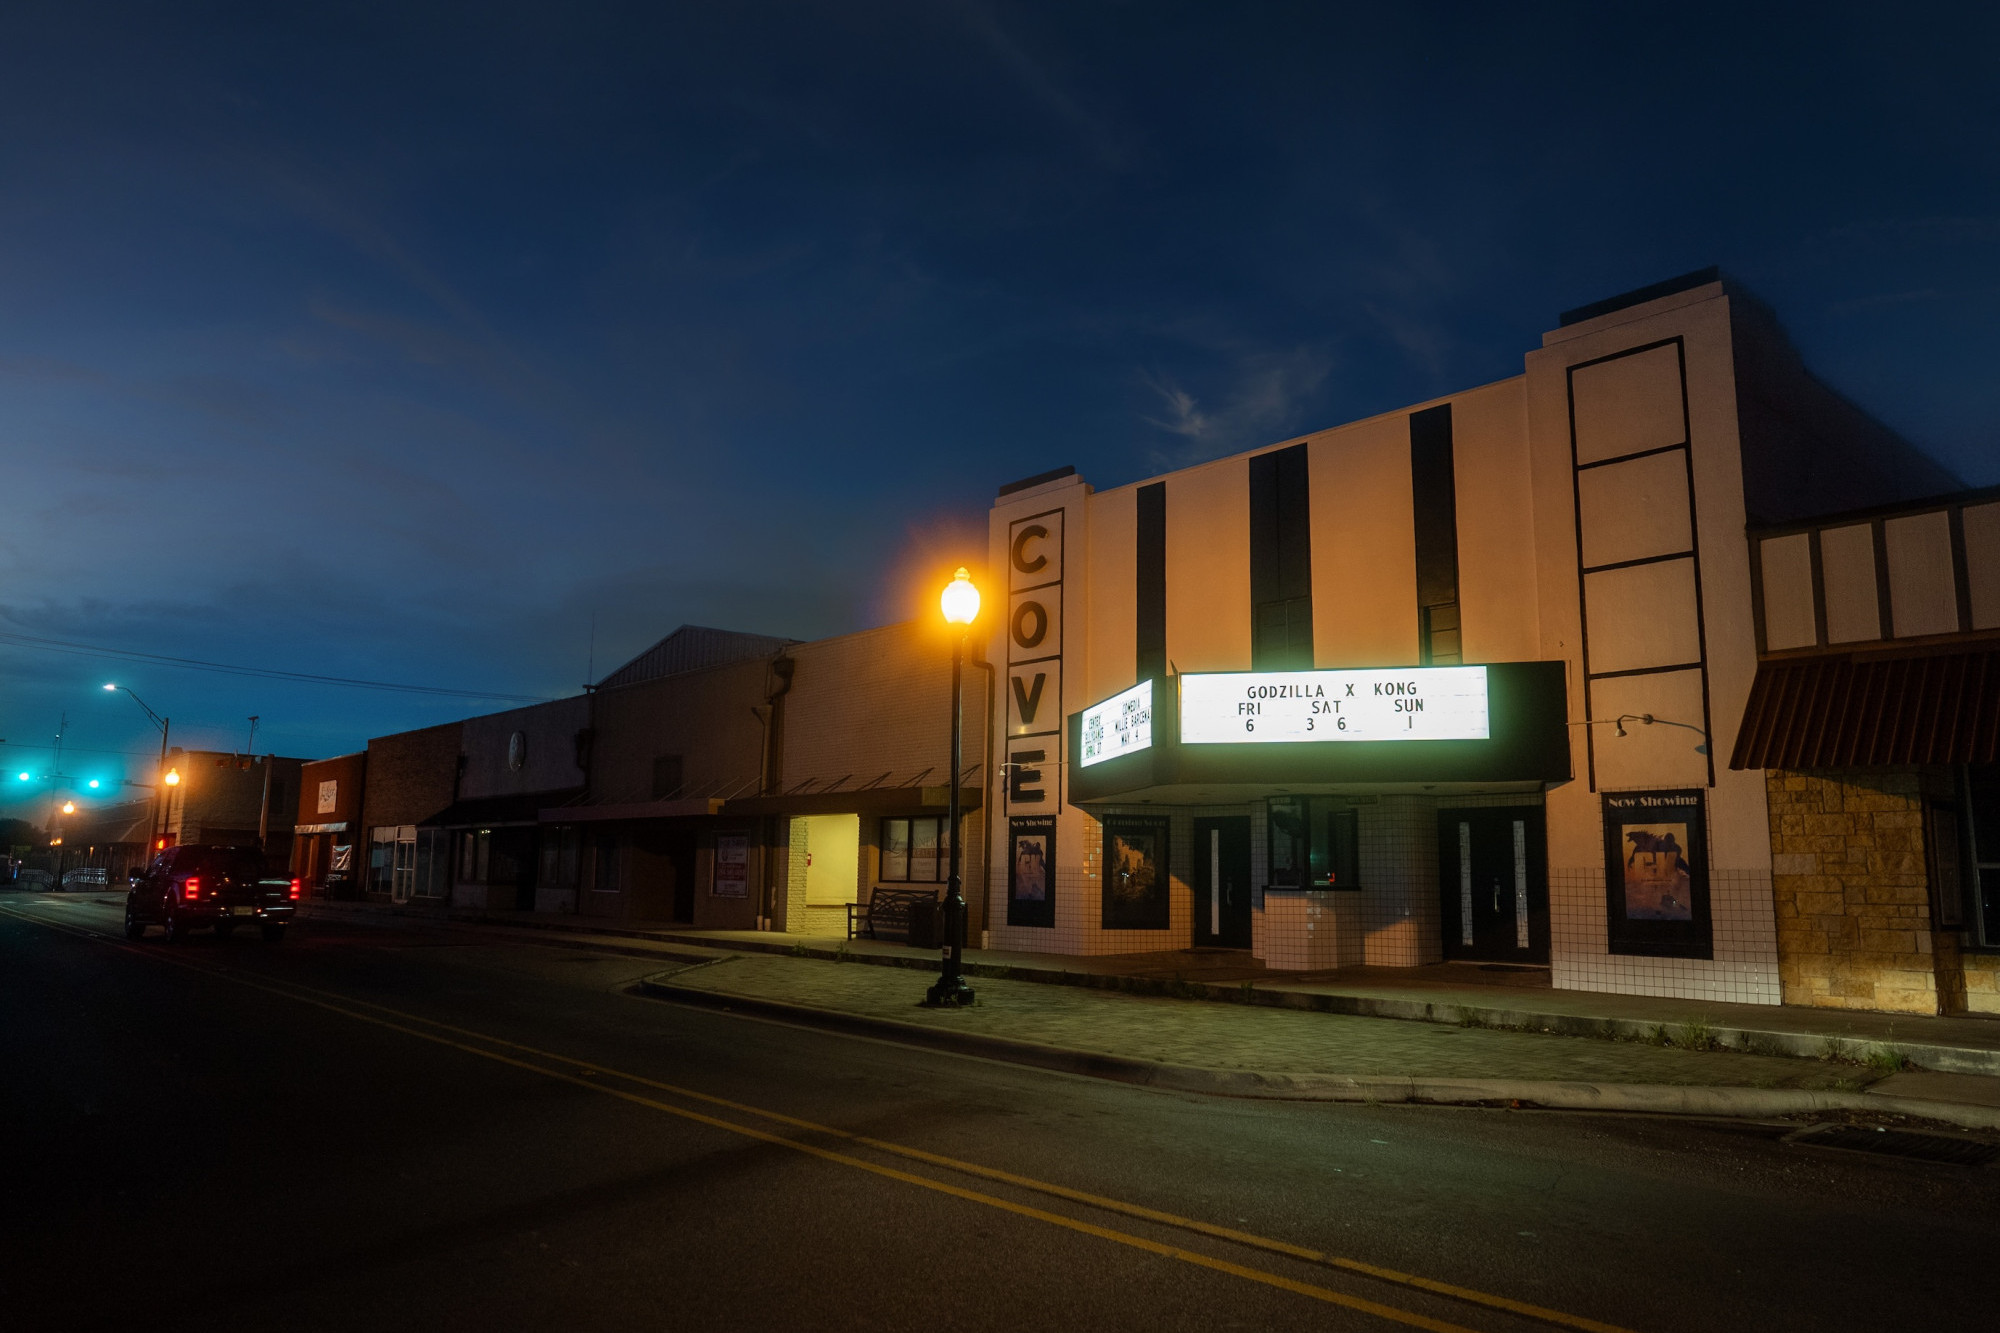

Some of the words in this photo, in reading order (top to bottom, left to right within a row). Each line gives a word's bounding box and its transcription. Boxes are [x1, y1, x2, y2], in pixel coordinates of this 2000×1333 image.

[1010, 524, 1048, 803] COVE
[1247, 685, 1324, 699] GODZILLA
[1345, 684, 1354, 697] X
[1374, 682, 1417, 696] KONG
[1238, 702, 1261, 715] FRI
[1312, 700, 1341, 714] SAT
[1394, 698, 1424, 712] SUN
[1246, 718, 1254, 732] 6
[1306, 718, 1314, 731] 3
[1337, 717, 1346, 730] 6
[1121, 731, 1131, 747] MAY
[1609, 798, 1636, 807] Now
[1640, 796, 1697, 807] Showing
